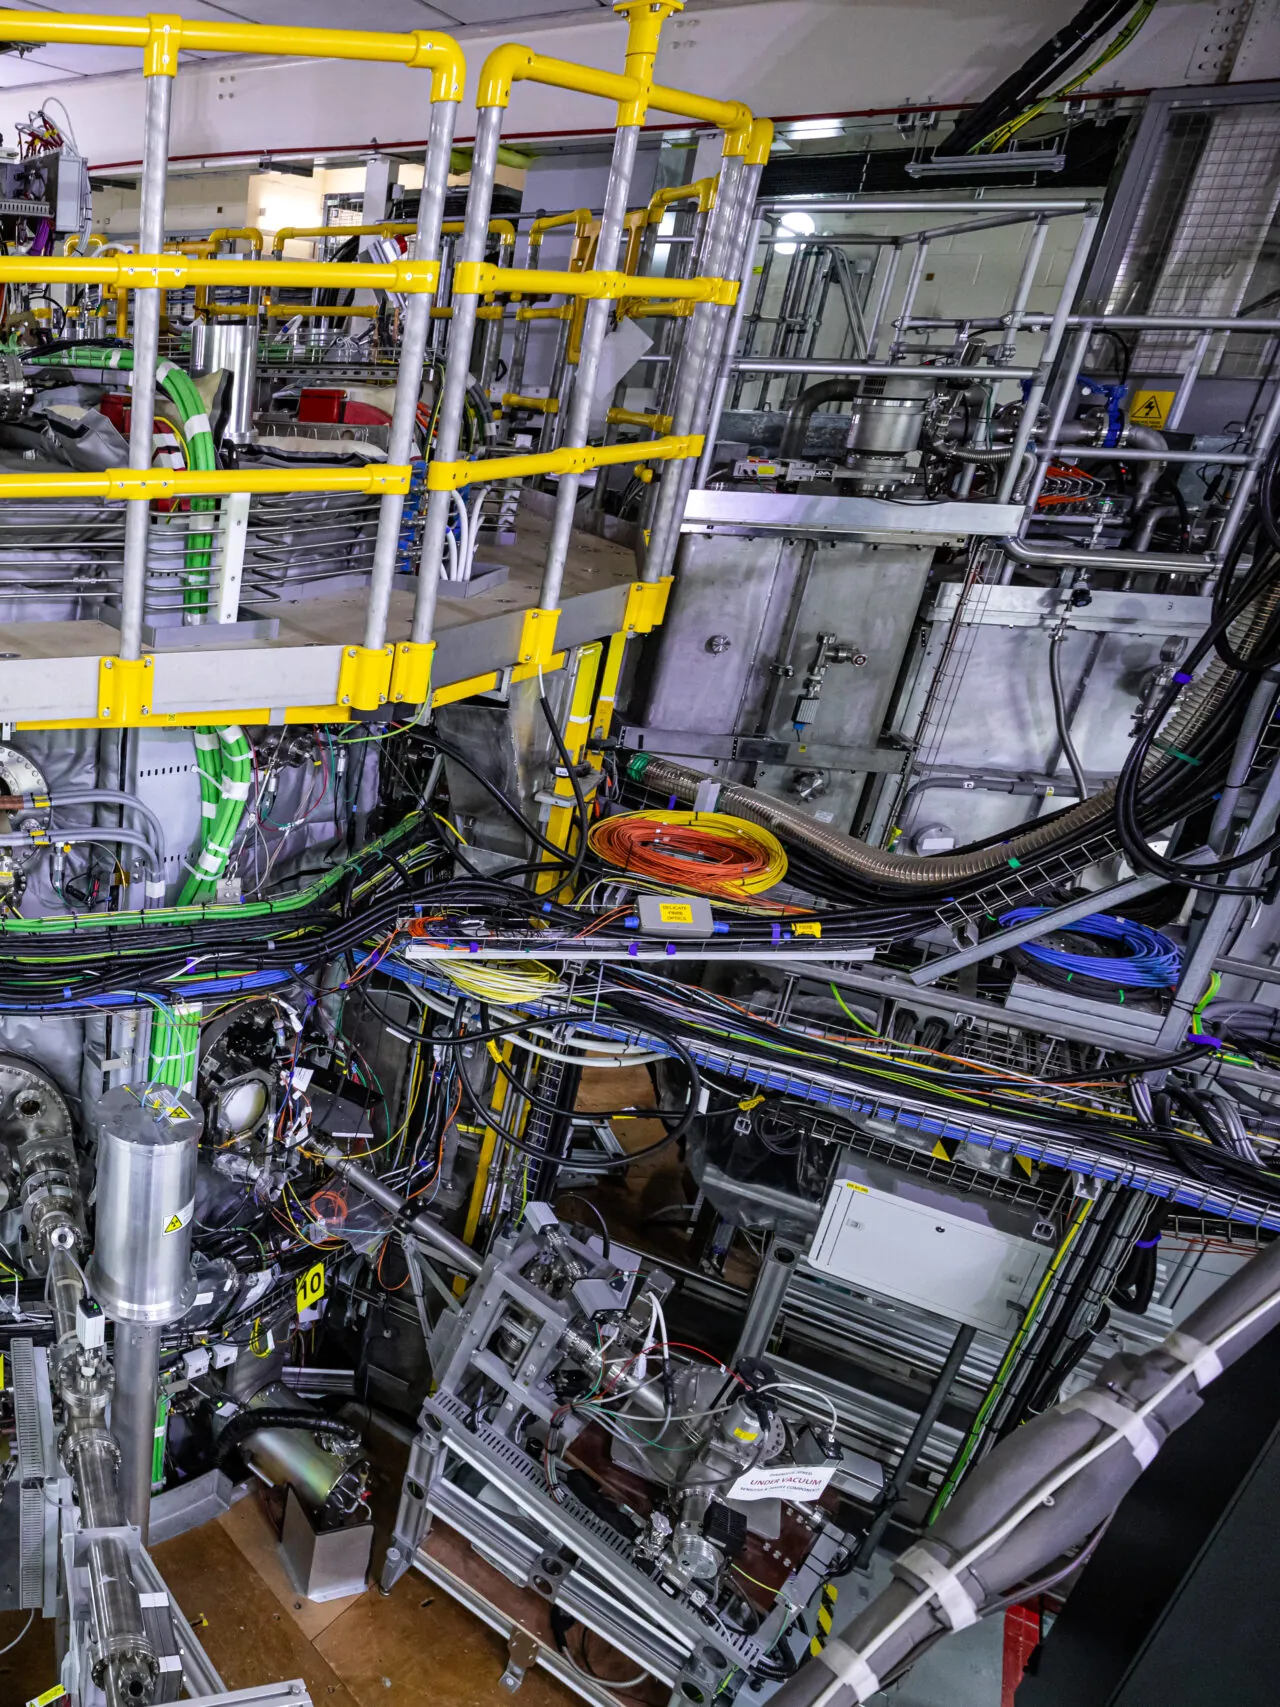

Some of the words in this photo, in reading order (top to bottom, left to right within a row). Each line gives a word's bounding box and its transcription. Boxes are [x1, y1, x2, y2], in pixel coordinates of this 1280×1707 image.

[300, 1272, 321, 1300] 10
[750, 1478, 779, 1486] UNDER
[781, 1477, 822, 1486] VACUUM
